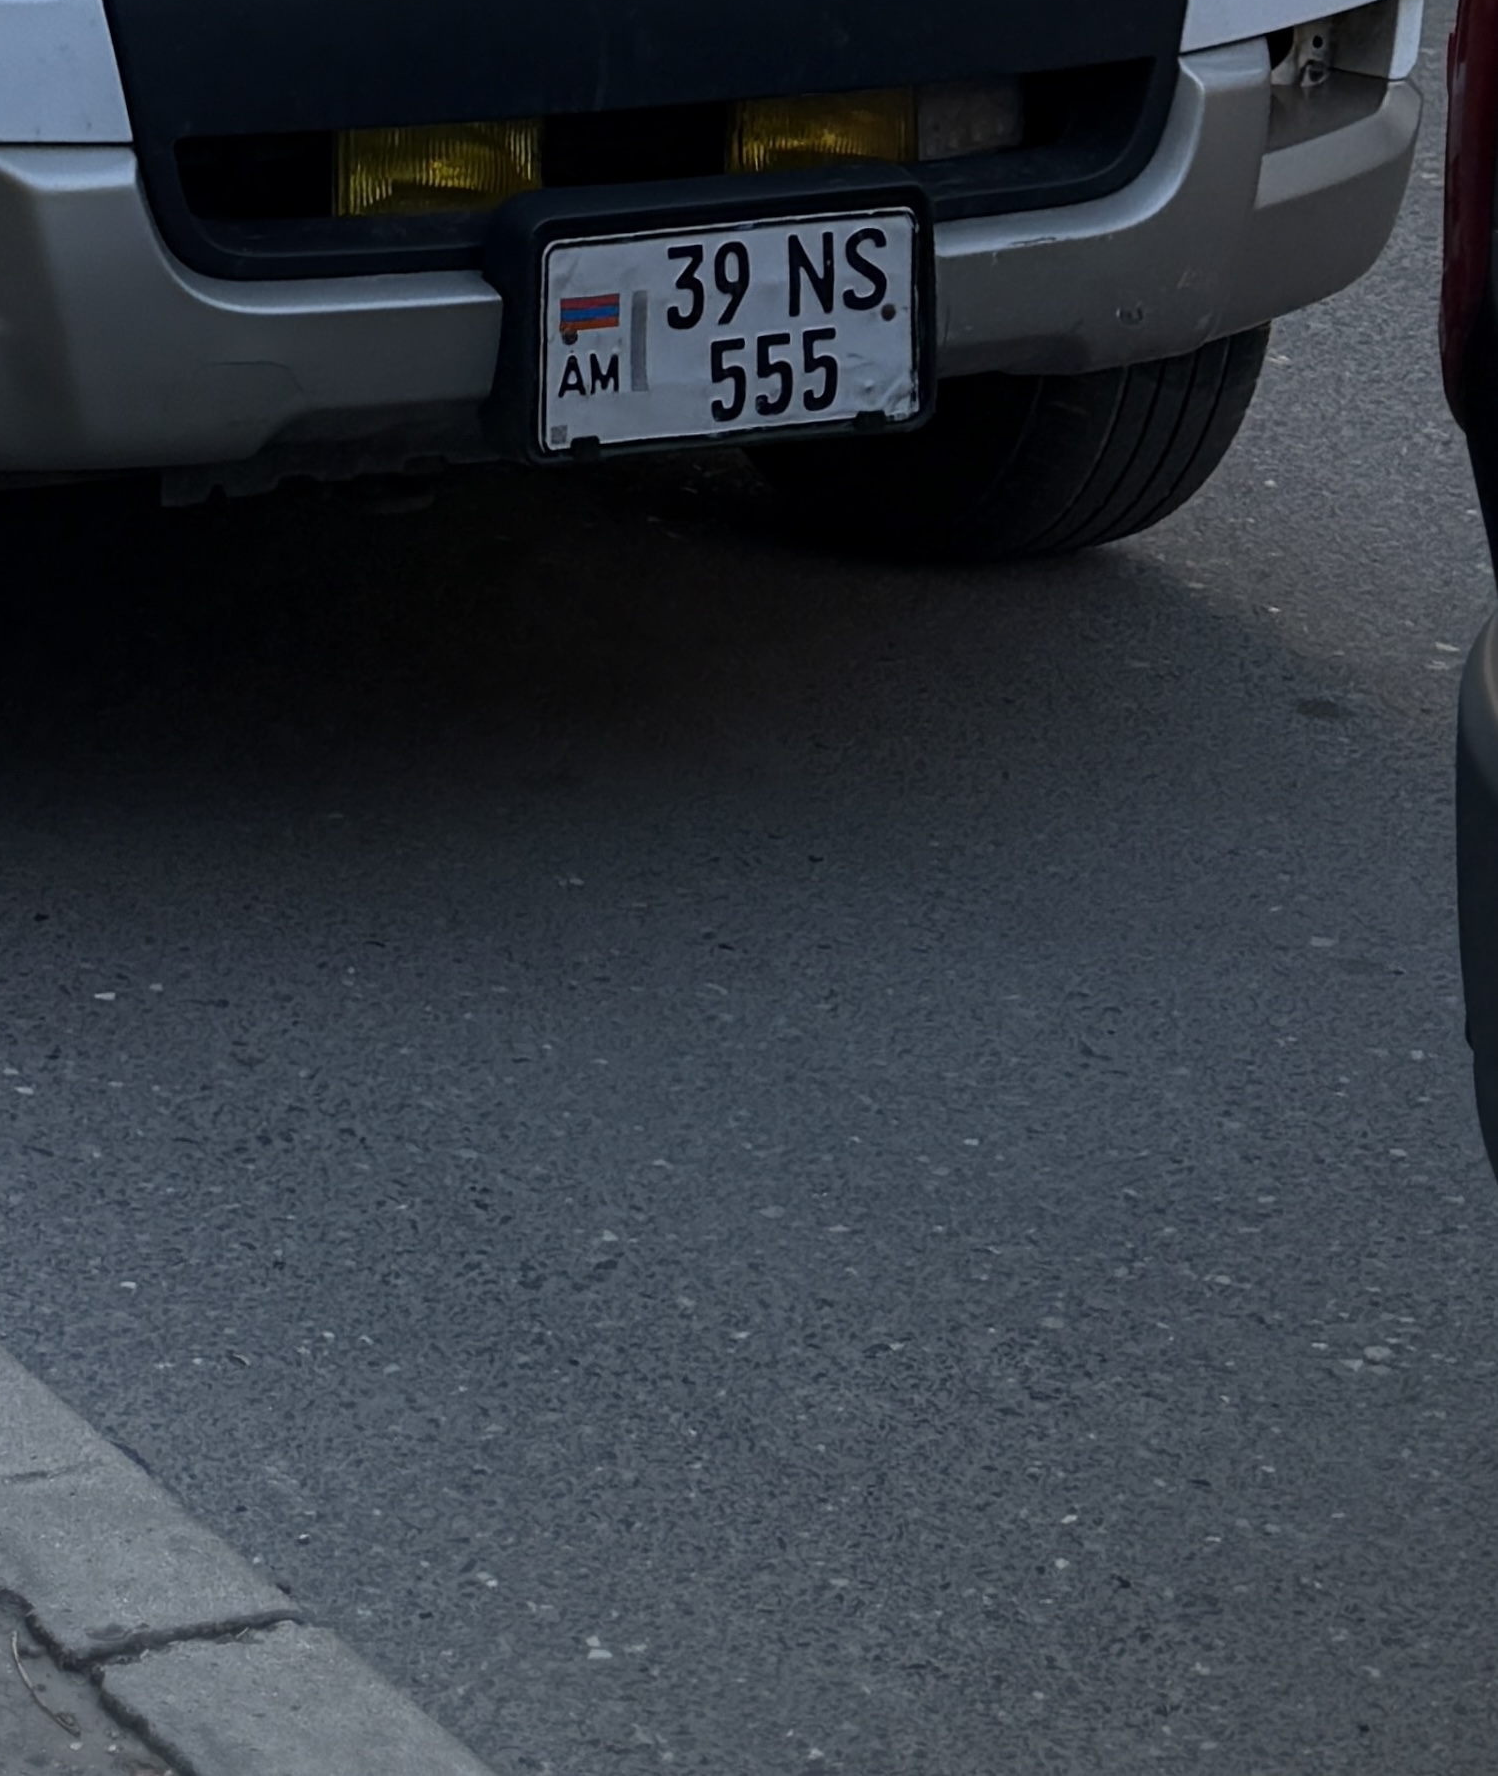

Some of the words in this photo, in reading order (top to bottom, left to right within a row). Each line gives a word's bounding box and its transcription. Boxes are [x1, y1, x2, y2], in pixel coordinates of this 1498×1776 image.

[666, 240, 751, 331] 39
[788, 227, 888, 318] NS
[558, 352, 620, 399] AM
[710, 327, 839, 423] 555
